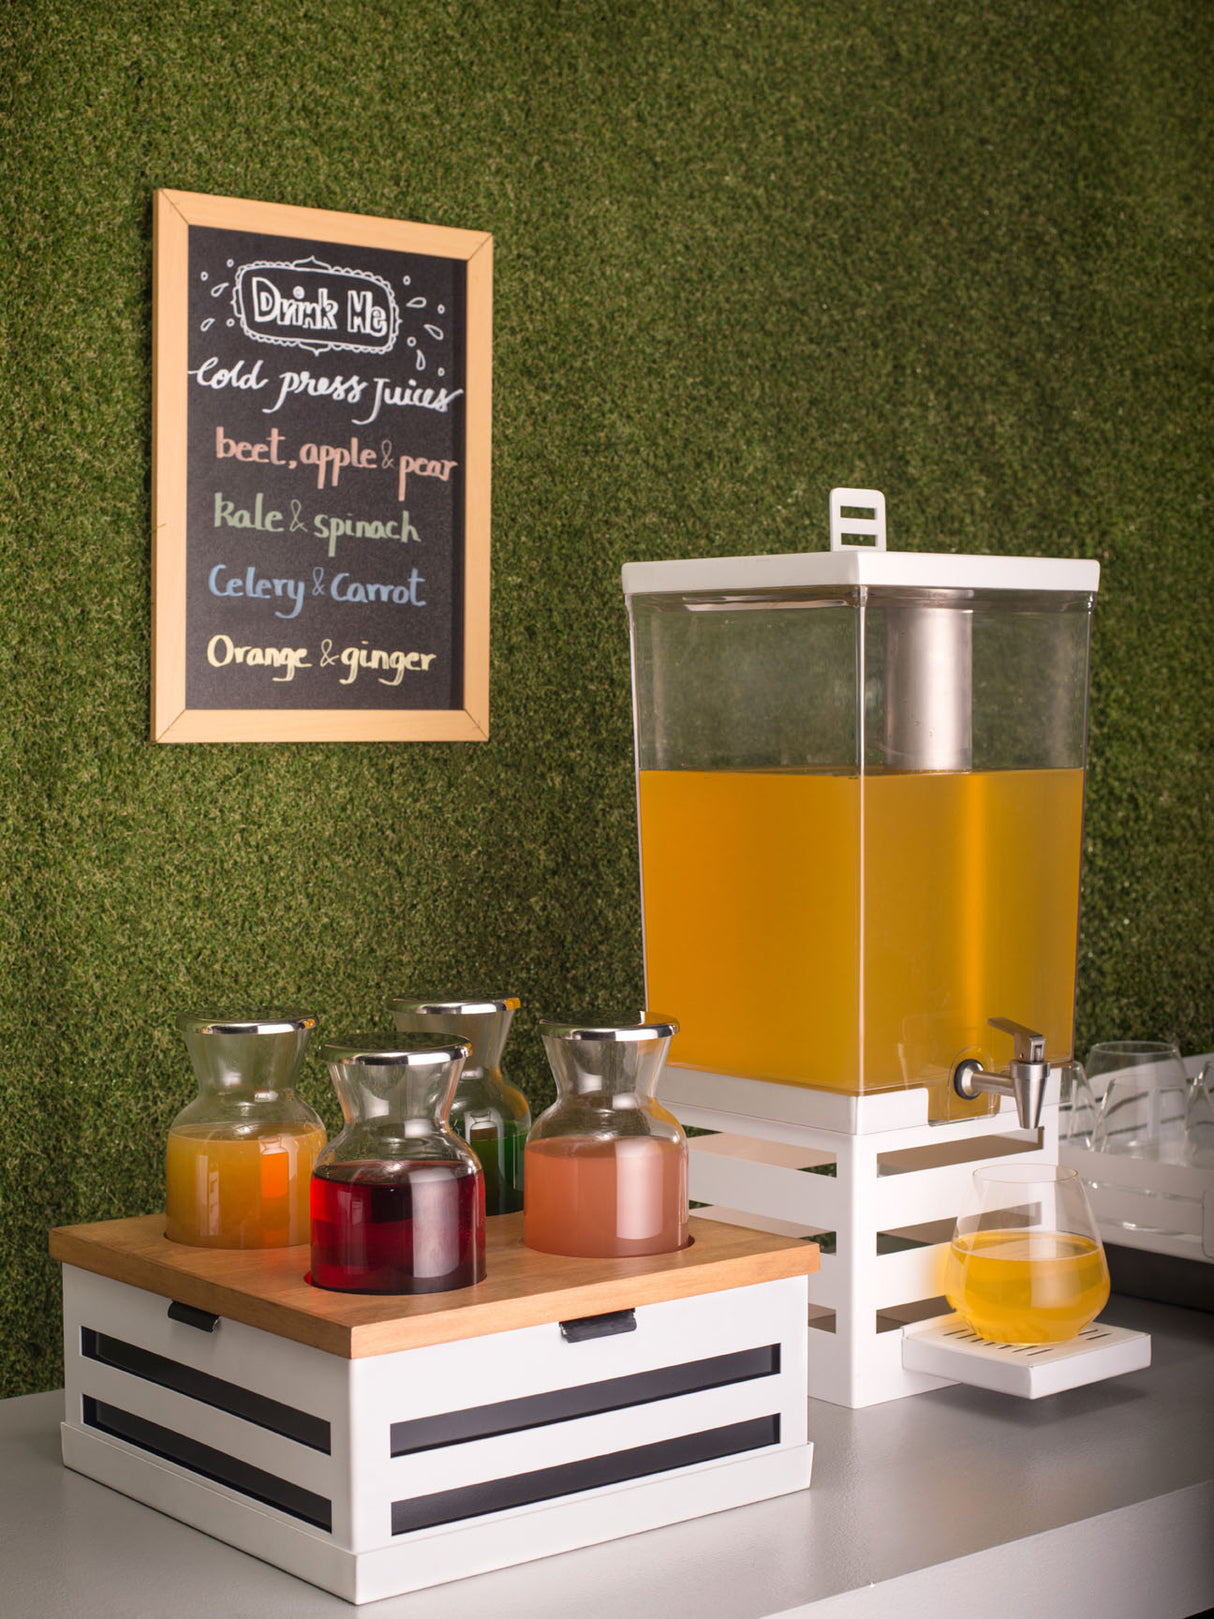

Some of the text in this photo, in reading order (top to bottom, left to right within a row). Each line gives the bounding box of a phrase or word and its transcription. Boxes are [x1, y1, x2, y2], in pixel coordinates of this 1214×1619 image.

[252, 277, 388, 337] Drink Me
[188, 357, 464, 425] Cold press Juices
[381, 439, 395, 469] &
[399, 455, 458, 501] pear
[289, 499, 308, 532] &
[314, 510, 421, 557] spinach
[208, 564, 426, 619] Celery & Carrot
[207, 635, 437, 686] Orange & ginger
